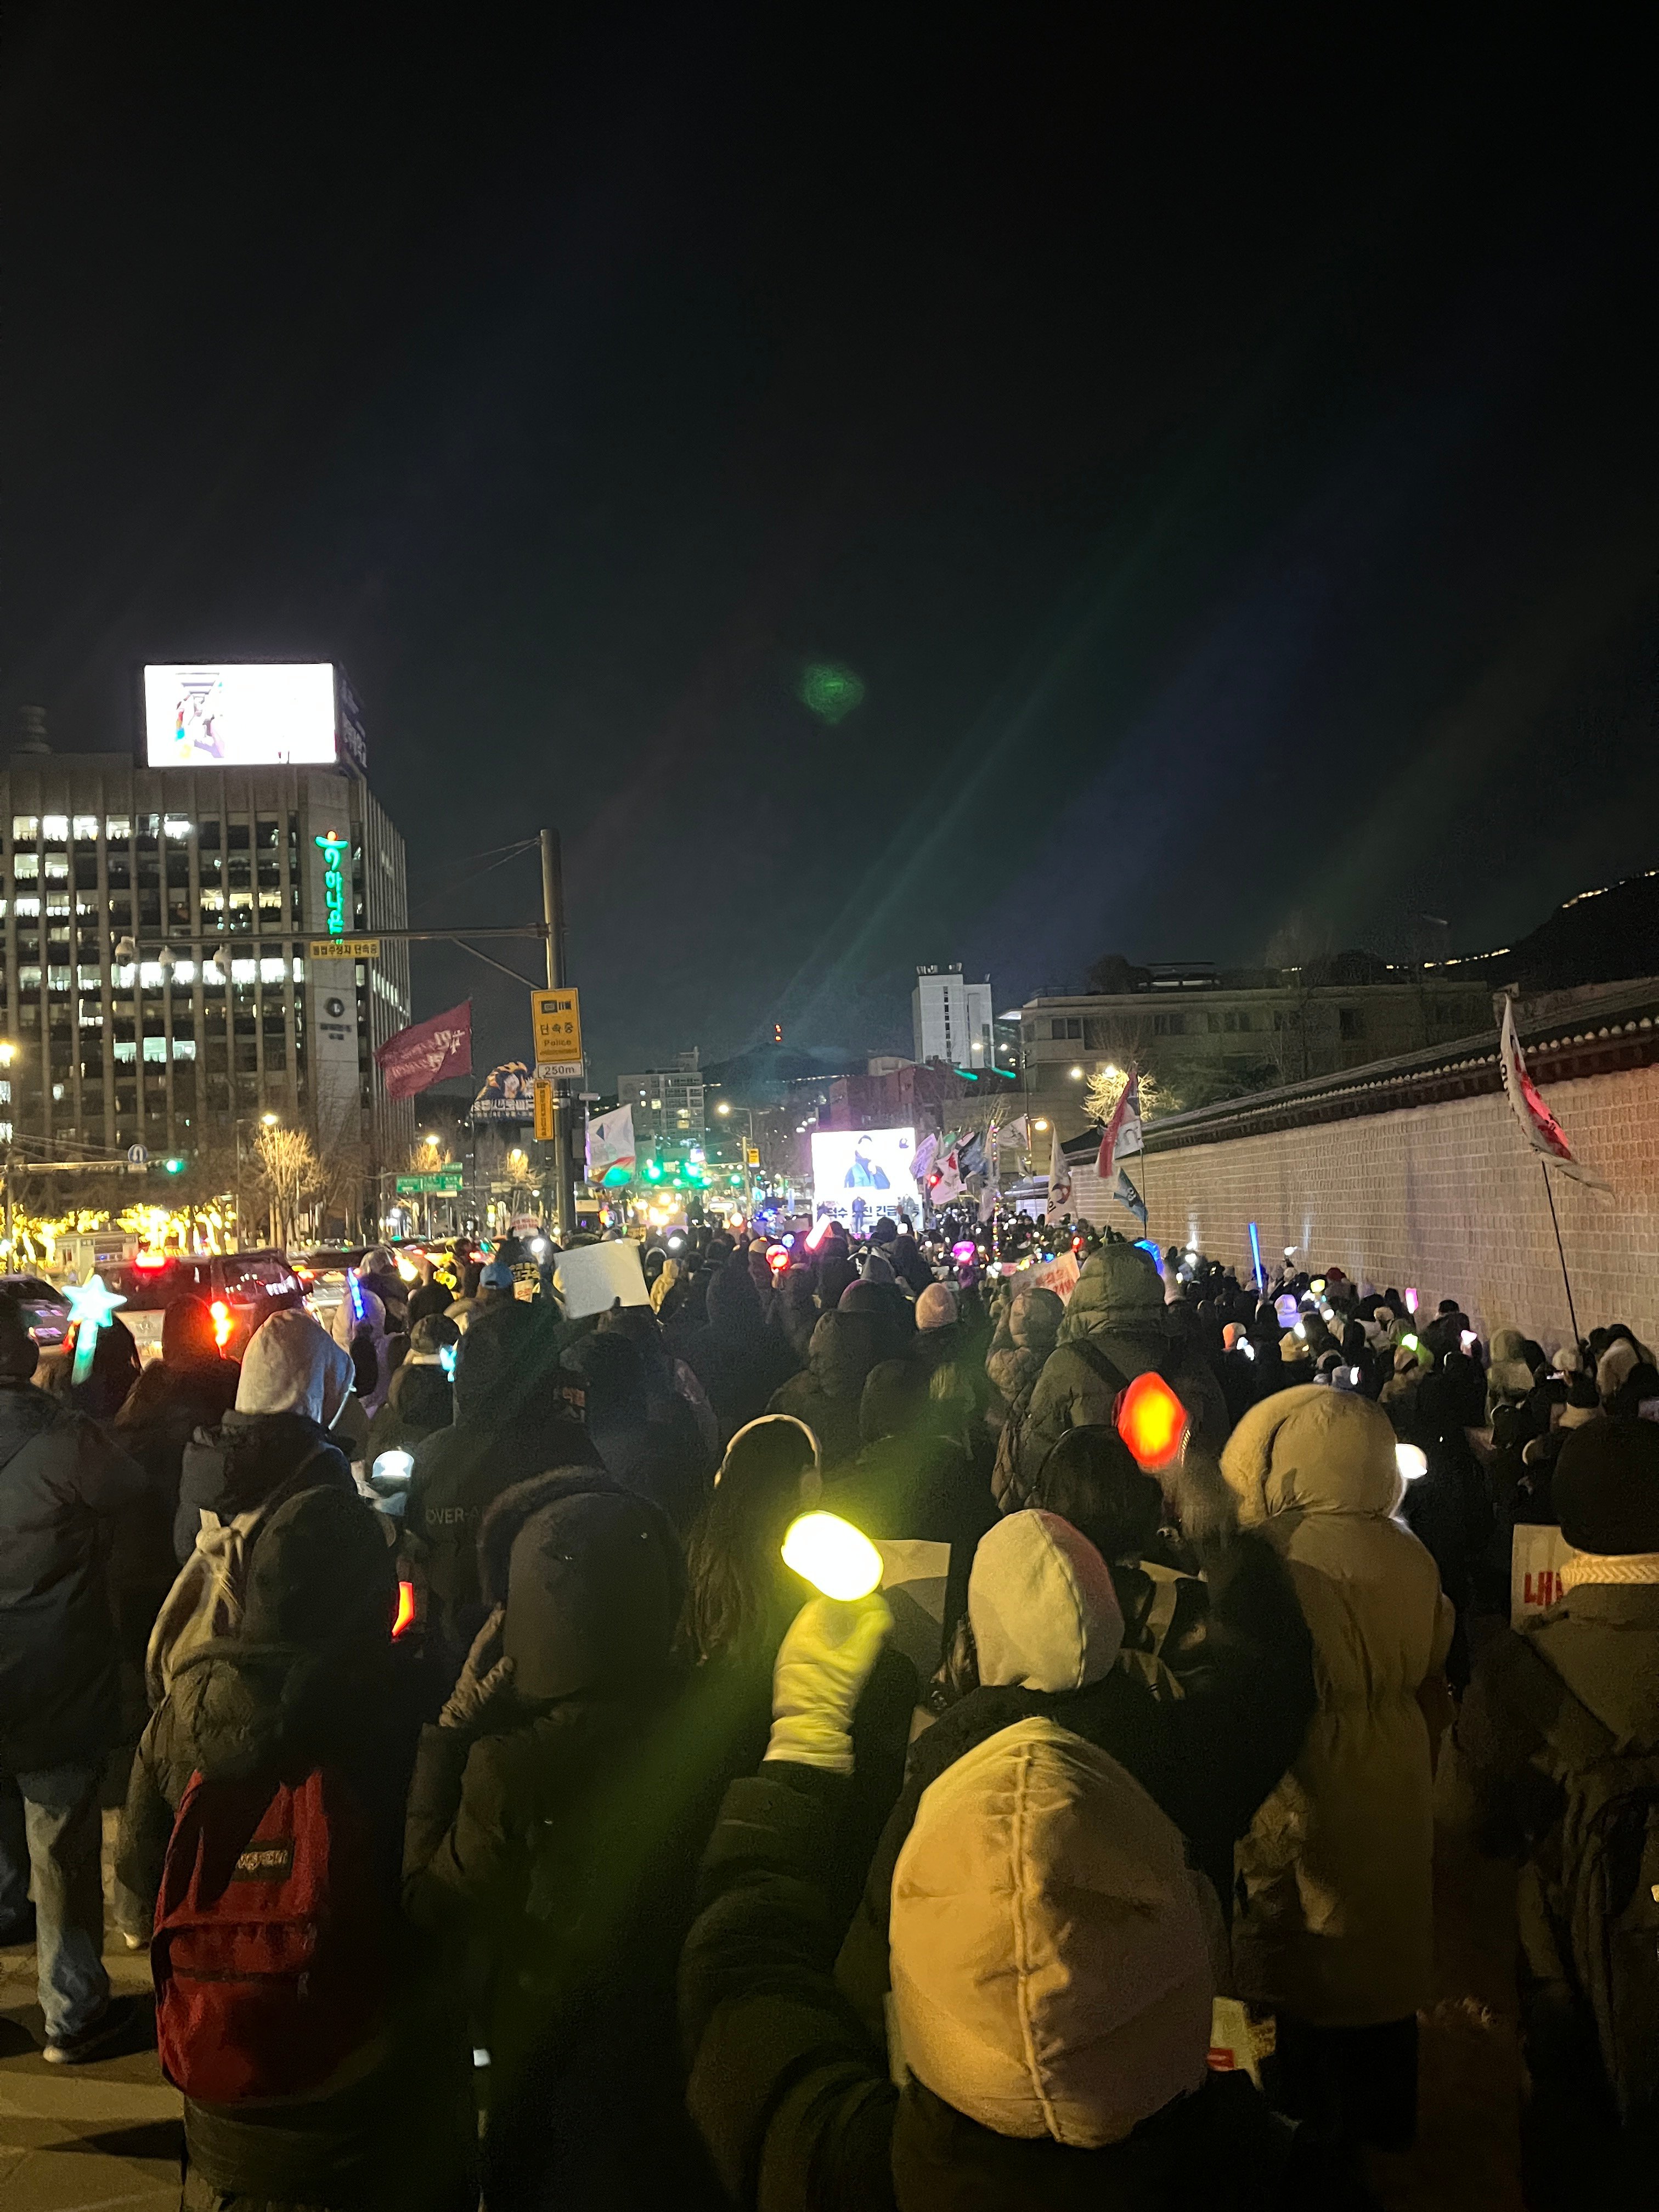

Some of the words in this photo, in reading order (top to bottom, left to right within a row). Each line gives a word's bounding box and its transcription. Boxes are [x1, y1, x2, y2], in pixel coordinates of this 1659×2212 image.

[325, 870, 344, 944] 하나은
[540, 1022, 573, 1035] 단속중
[544, 1065, 575, 1076] 250m
